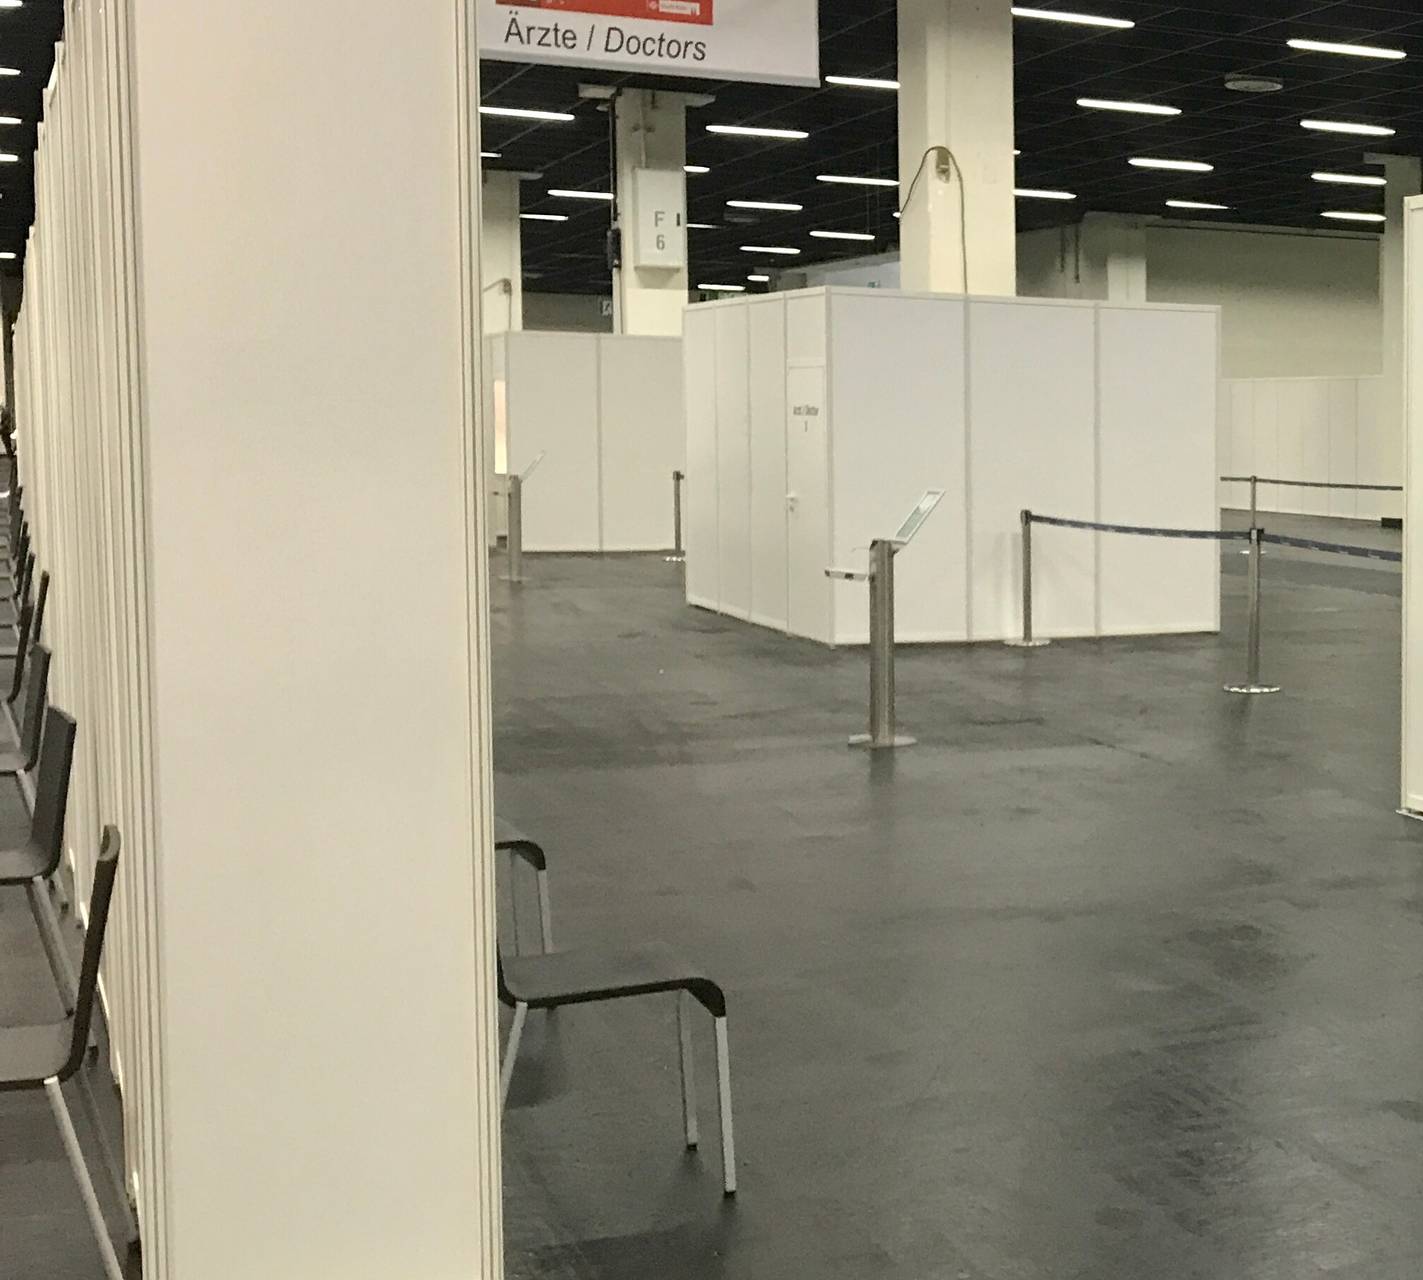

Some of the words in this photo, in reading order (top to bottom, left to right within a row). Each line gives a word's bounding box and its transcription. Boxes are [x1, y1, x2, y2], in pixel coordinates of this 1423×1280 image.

[504, 11, 577, 49] Ärzte
[586, 25, 595, 50] /
[604, 27, 707, 61] Doctors
[654, 211, 665, 227] F
[655, 234, 665, 251] 6
